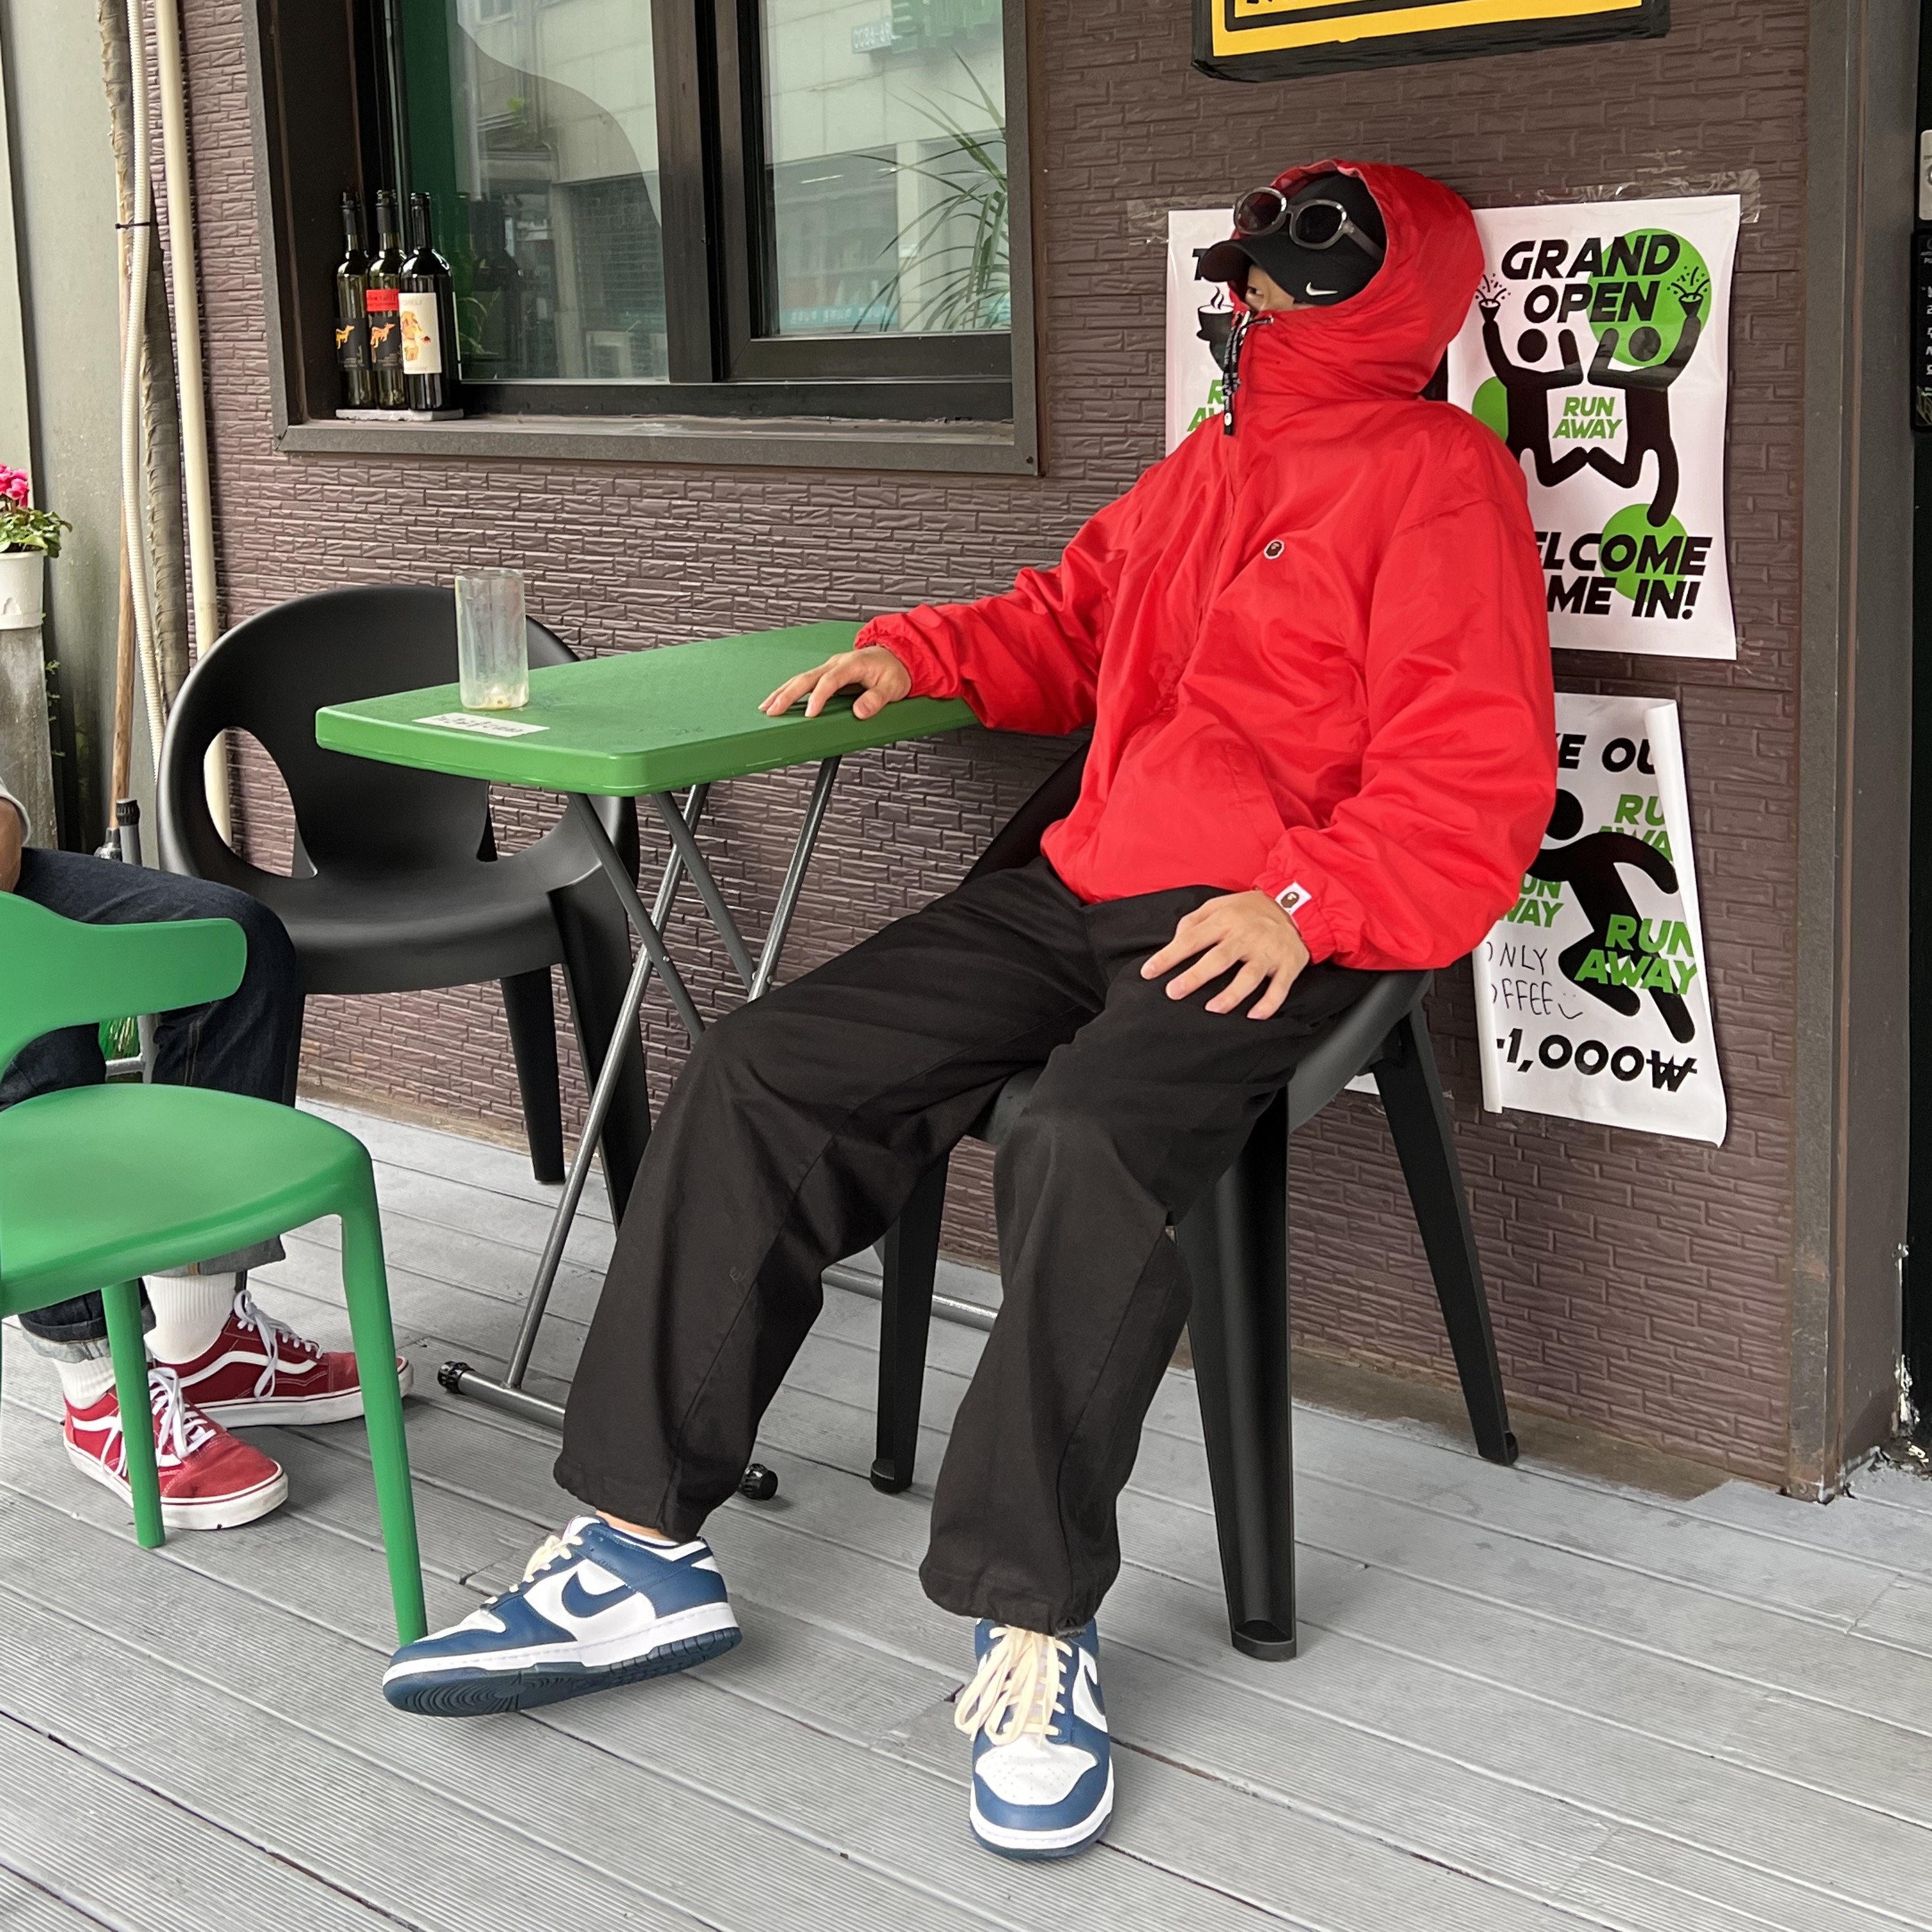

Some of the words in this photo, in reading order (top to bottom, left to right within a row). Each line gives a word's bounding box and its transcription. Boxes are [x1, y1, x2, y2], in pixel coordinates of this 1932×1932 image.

[1501, 234, 1680, 280] GRAND
[1524, 280, 1660, 323] OPEN
[1552, 418, 1623, 439] AWAY
[1563, 397, 1615, 417] RUN
[1632, 579, 1701, 620] IN!
[1605, 914, 1694, 958] RUN
[1574, 949, 1698, 995] AWAY
